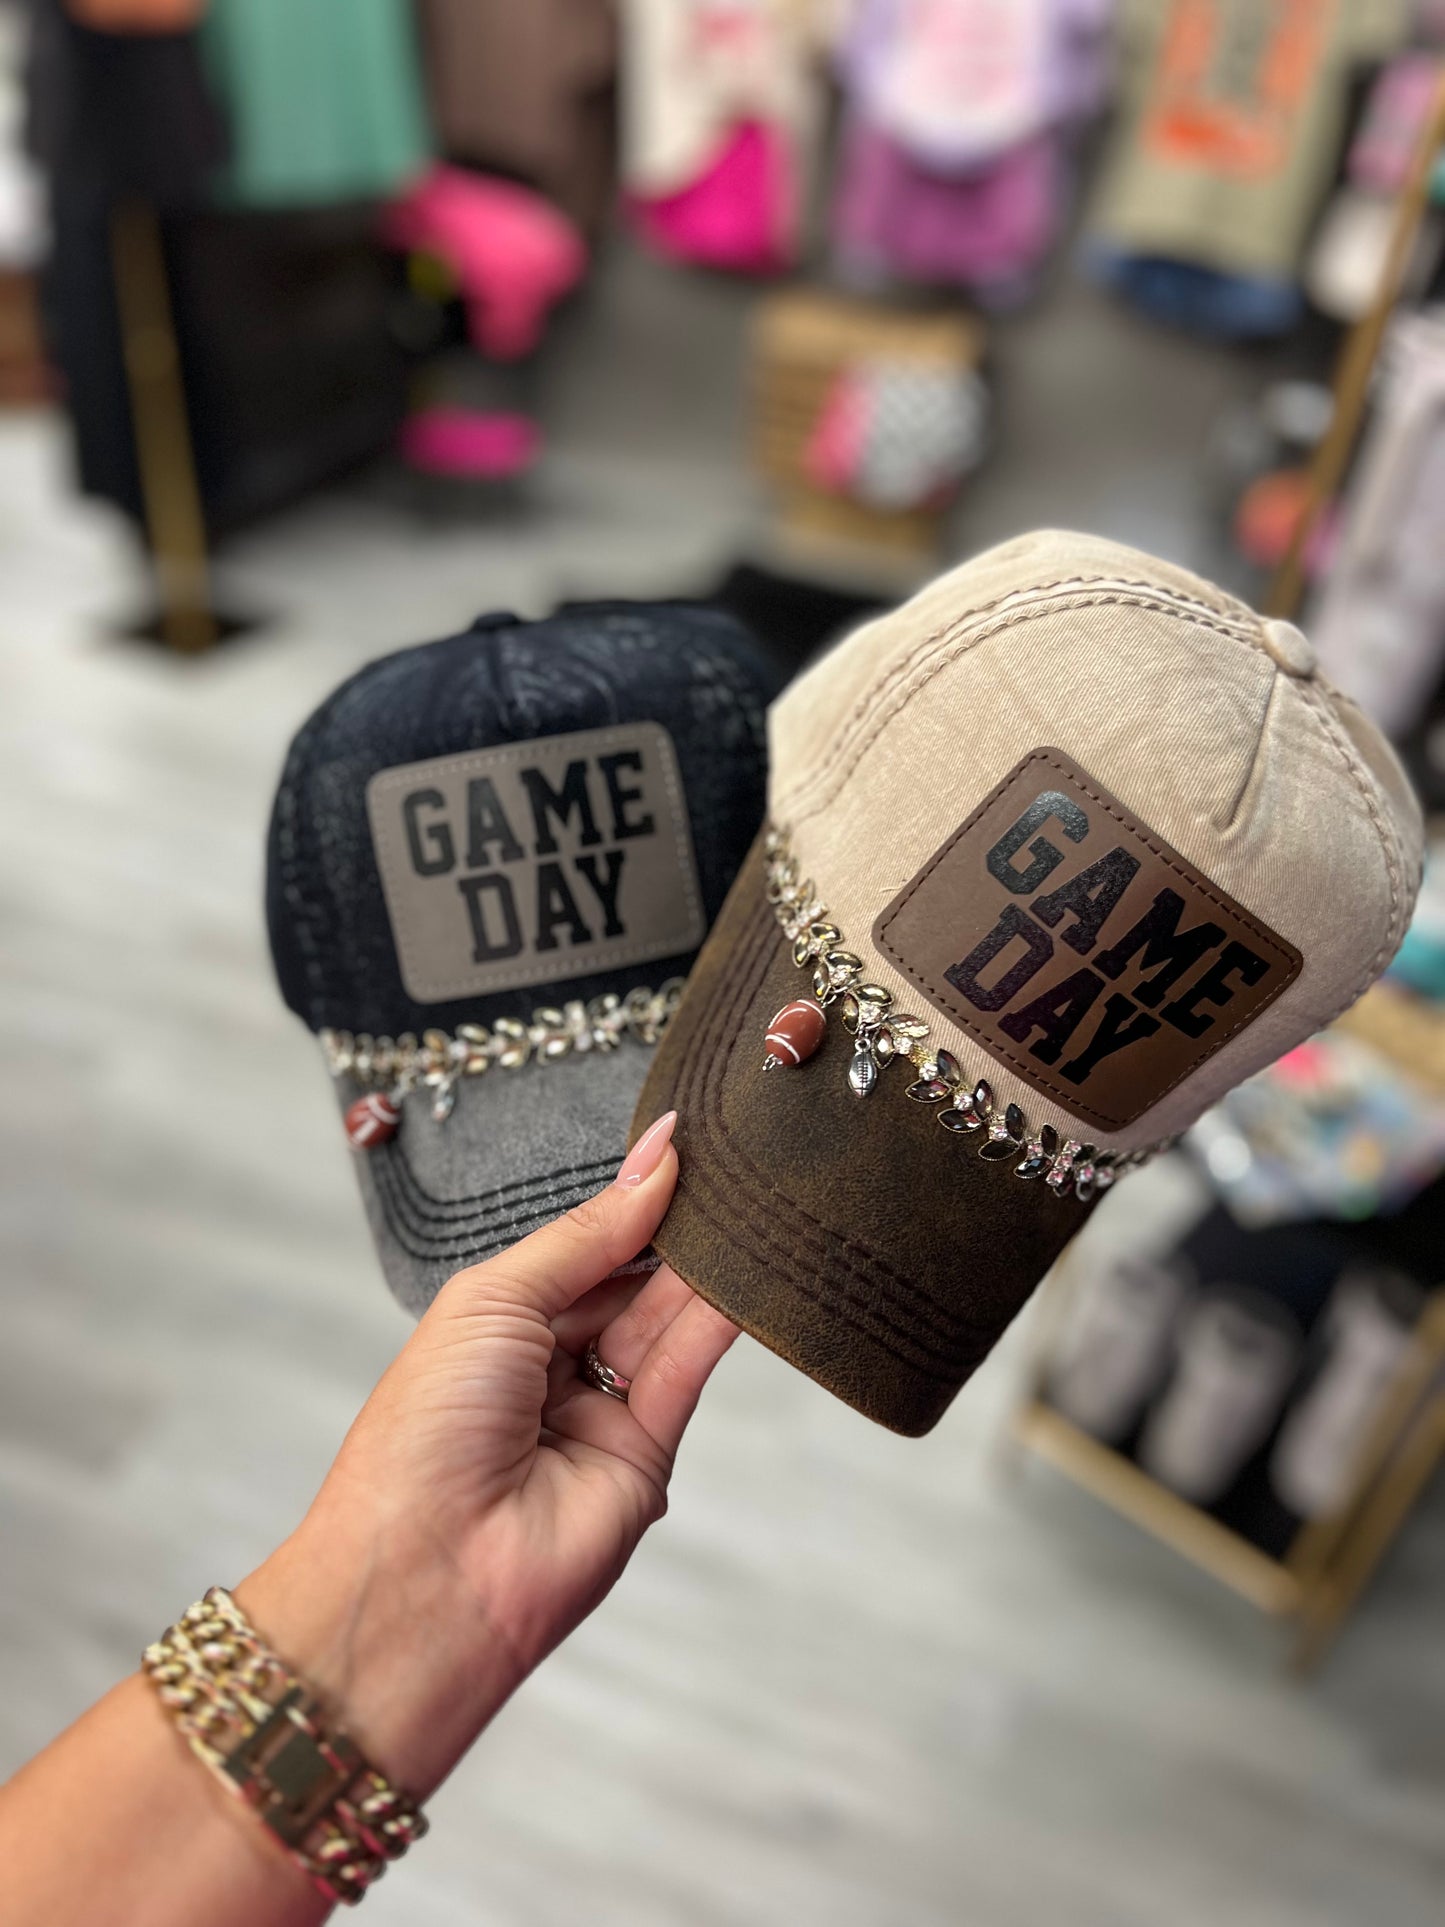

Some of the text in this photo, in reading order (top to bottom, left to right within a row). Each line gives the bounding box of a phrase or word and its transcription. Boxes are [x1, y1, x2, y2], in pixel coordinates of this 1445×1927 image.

[402, 751, 654, 878] GAME
[458, 850, 625, 964] DAY
[986, 790, 1271, 1039] GAME
[943, 902, 1162, 1085] DAY
